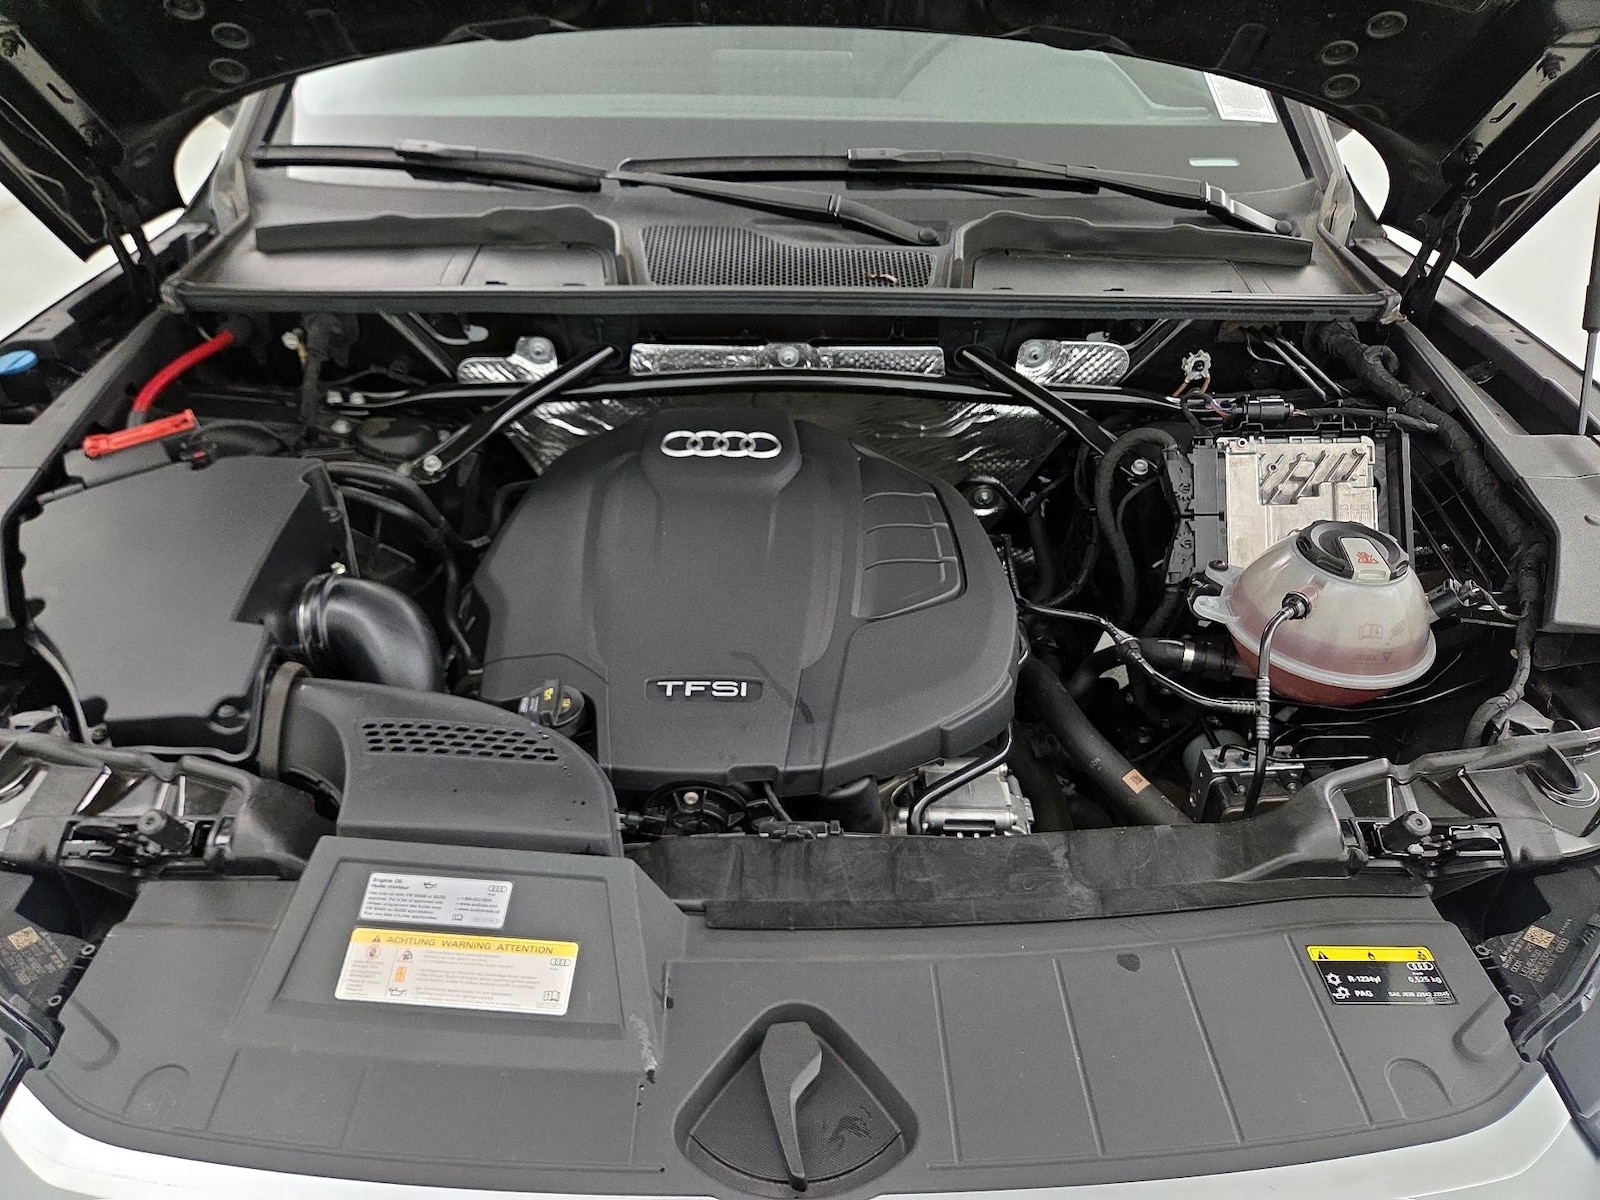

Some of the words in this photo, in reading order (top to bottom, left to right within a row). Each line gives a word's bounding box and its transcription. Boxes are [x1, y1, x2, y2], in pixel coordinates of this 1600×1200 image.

[656, 680, 748, 697] TFSI
[386, 935, 436, 946] ACHTUNG
[442, 939, 492, 950] WARNING
[496, 943, 554, 954] ATTENTION
[1430, 976, 1443, 984] kg
[1354, 990, 1374, 998] PAG
